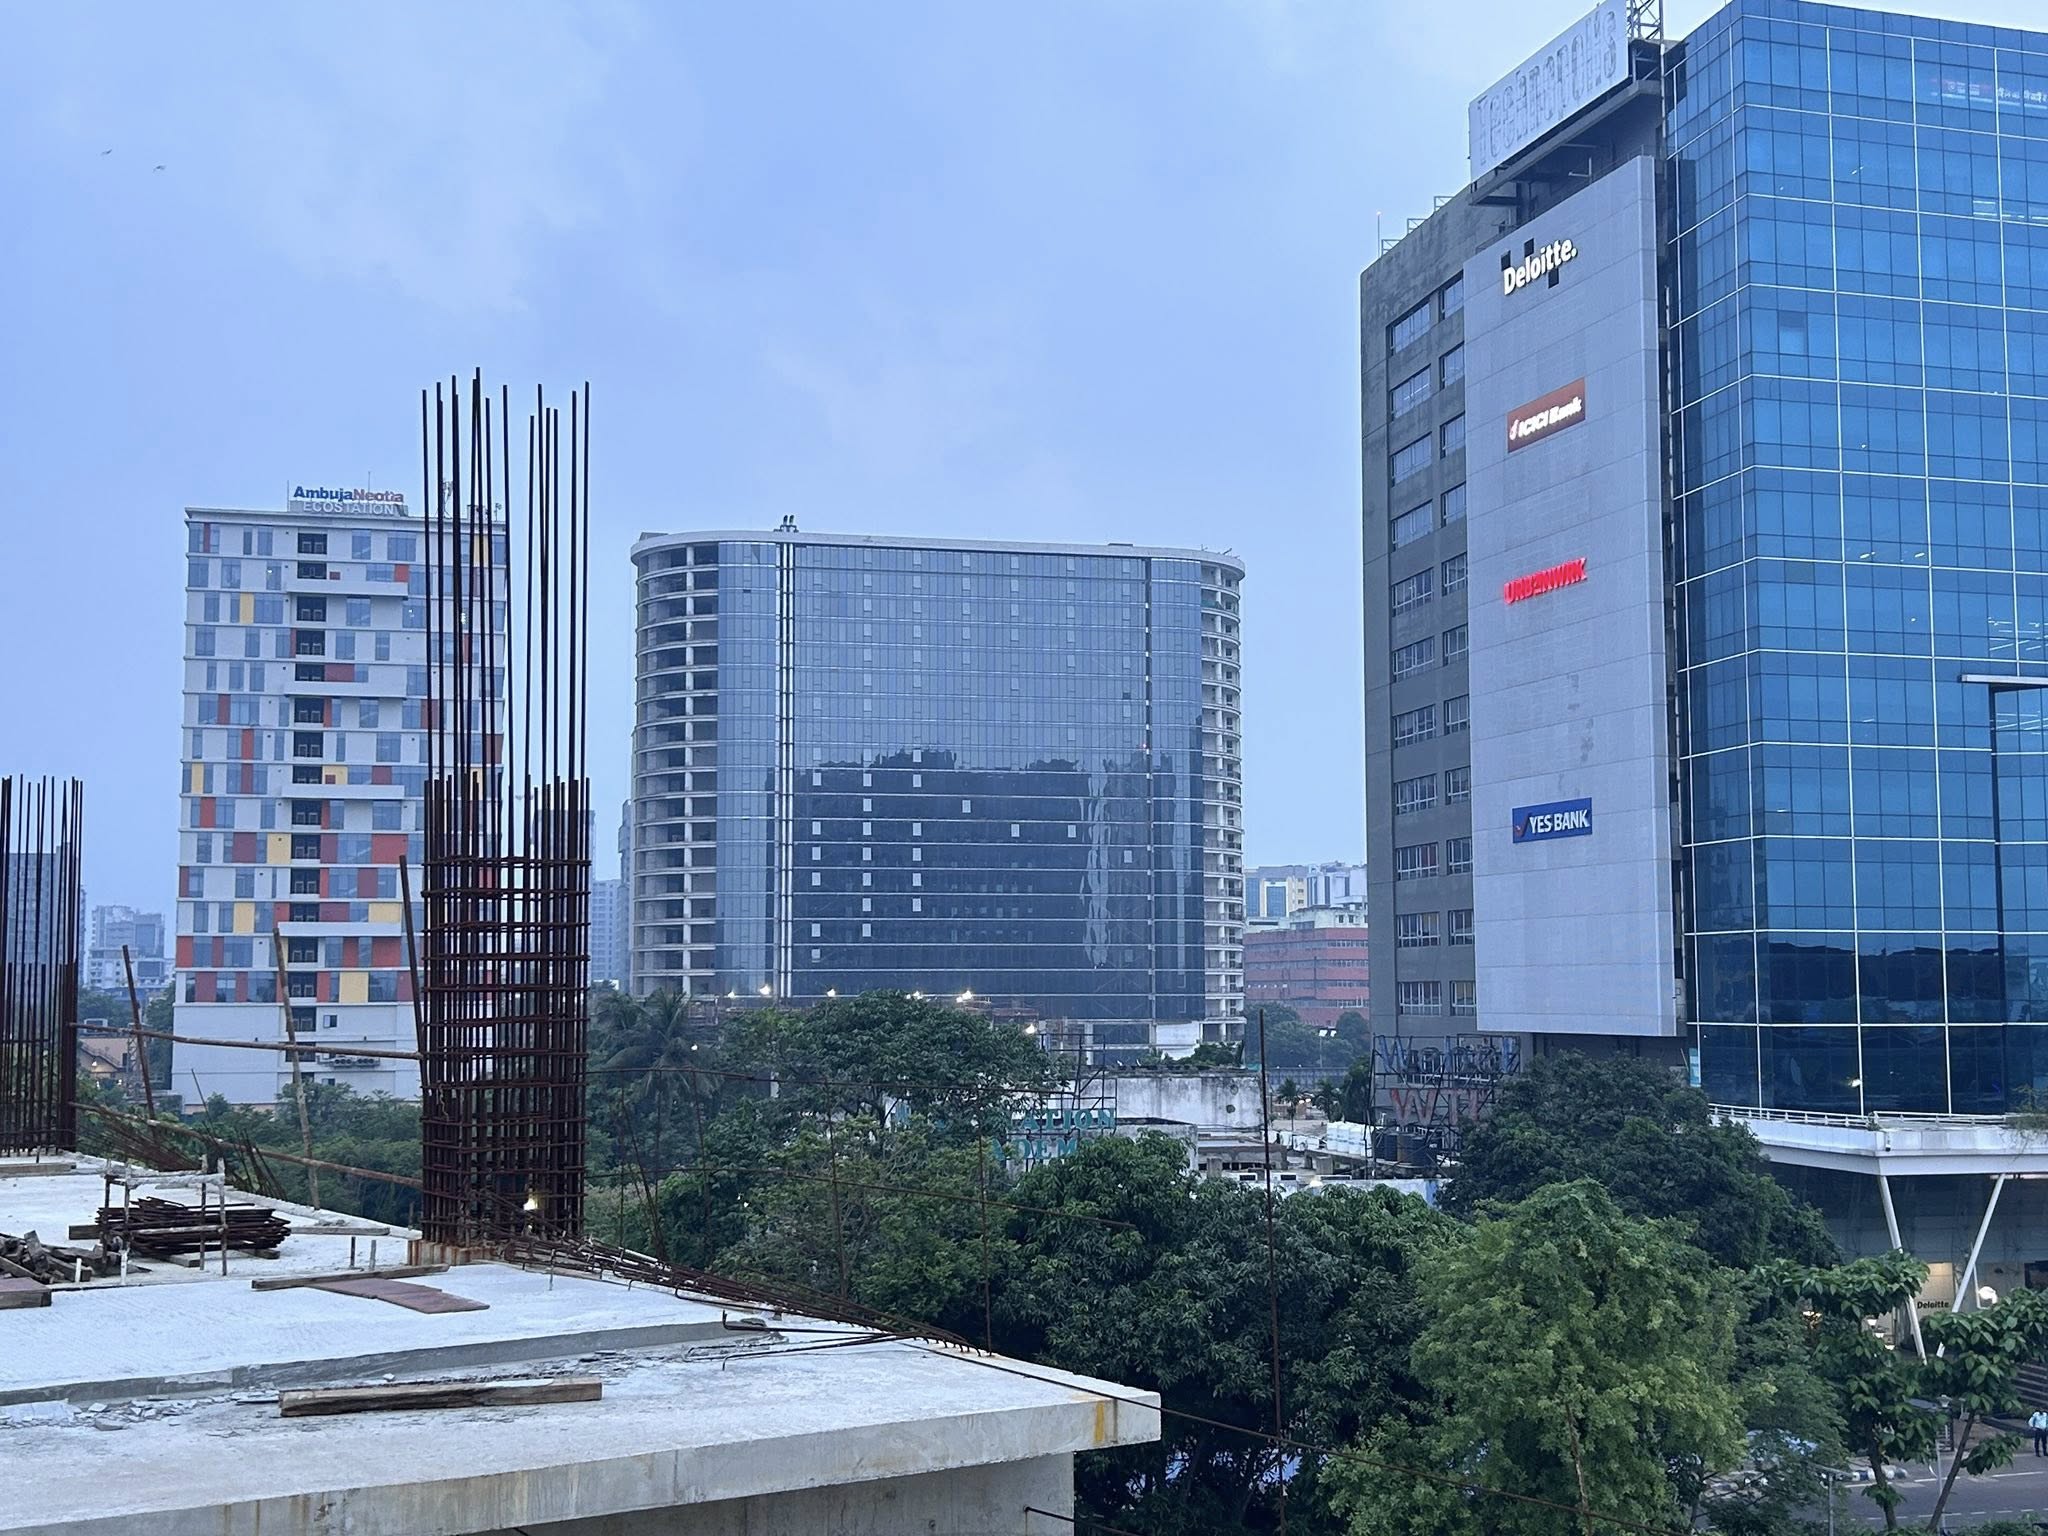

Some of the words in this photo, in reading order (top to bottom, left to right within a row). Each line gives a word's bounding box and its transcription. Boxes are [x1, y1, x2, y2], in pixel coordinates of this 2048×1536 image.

[1549, 396, 1582, 425] Bank
[303, 501, 394, 515] ECOSTATION
[1529, 813, 1552, 834] YES
[1553, 809, 1590, 830] BANK
[1011, 1108, 1116, 1130] ATION
[1917, 1300, 1949, 1309] Deloitte
